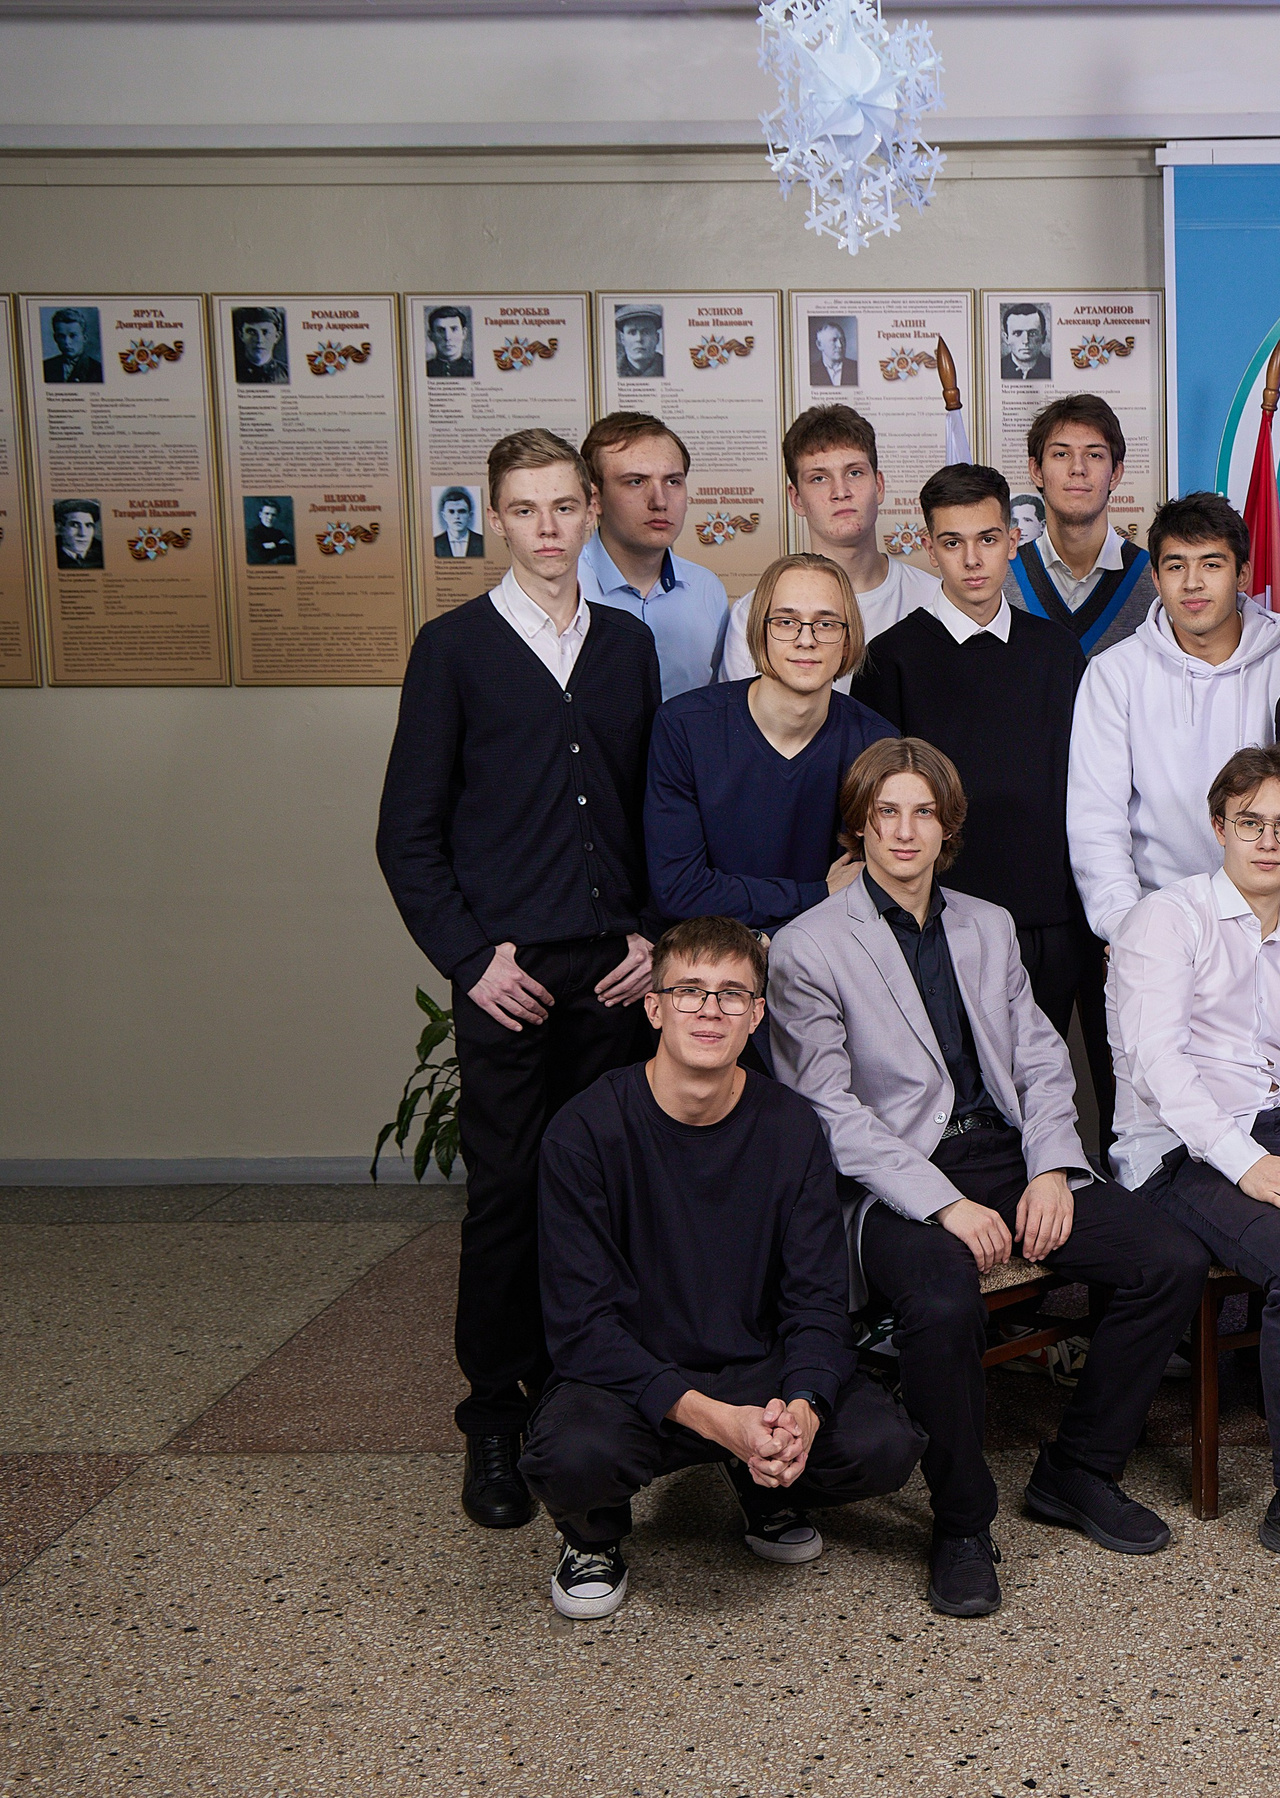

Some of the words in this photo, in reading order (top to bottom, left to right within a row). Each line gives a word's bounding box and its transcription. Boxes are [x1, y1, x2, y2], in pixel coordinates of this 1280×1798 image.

[132, 309, 165, 319] ЯРУТА
[310, 310, 360, 319] РОМАНОВ
[500, 307, 550, 316] ВОРОБЬЕВ
[697, 306, 744, 316] КУЛИКОВ
[1073, 305, 1135, 315] АРТАМОНОВ
[115, 320, 154, 331] Дмитрий
[155, 320, 184, 331] Ильич
[302, 321, 323, 331] Петр
[326, 321, 370, 331] Андреевич
[522, 316, 567, 327] Андреевич
[688, 318, 710, 327] Иван
[712, 318, 754, 327] Иванович
[891, 319, 927, 328] ЛАПИН
[1057, 316, 1101, 327] Александр
[1103, 316, 1151, 327] Алексеевич
[877, 330, 911, 340] Герасим
[913, 330, 940, 340] Ильич
[696, 487, 755, 496] ЛИПОВЕЦЕР
[324, 493, 367, 503] ШЛЯХОВ
[719, 496, 764, 505] Яковлевич
[894, 497, 919, 506] ВЛАС
[1108, 495, 1135, 504] ОНОВ
[129, 499, 179, 509] КАСАБИЕВ
[309, 503, 347, 514] Дмитрий
[349, 503, 381, 514] Агеевич
[878, 507, 913, 516] стантин
